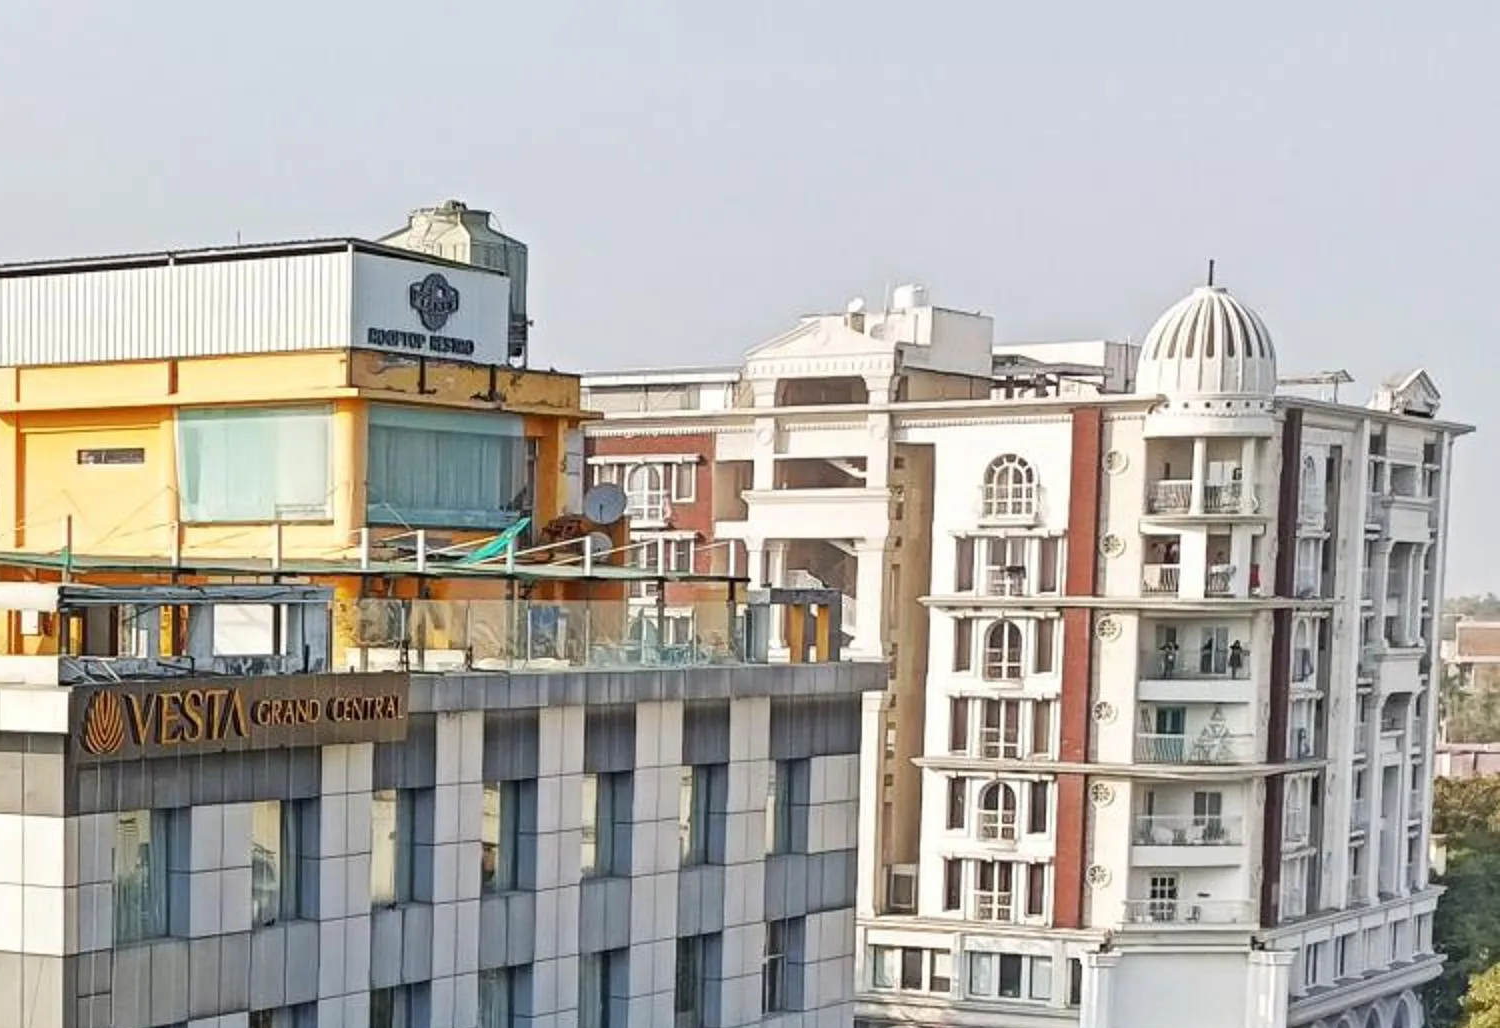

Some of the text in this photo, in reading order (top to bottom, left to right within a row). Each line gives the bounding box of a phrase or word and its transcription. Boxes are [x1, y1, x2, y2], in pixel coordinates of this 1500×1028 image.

[368, 327, 426, 350] ROOFTOP
[124, 687, 404, 745] VESTA GRAND CENTRAL
